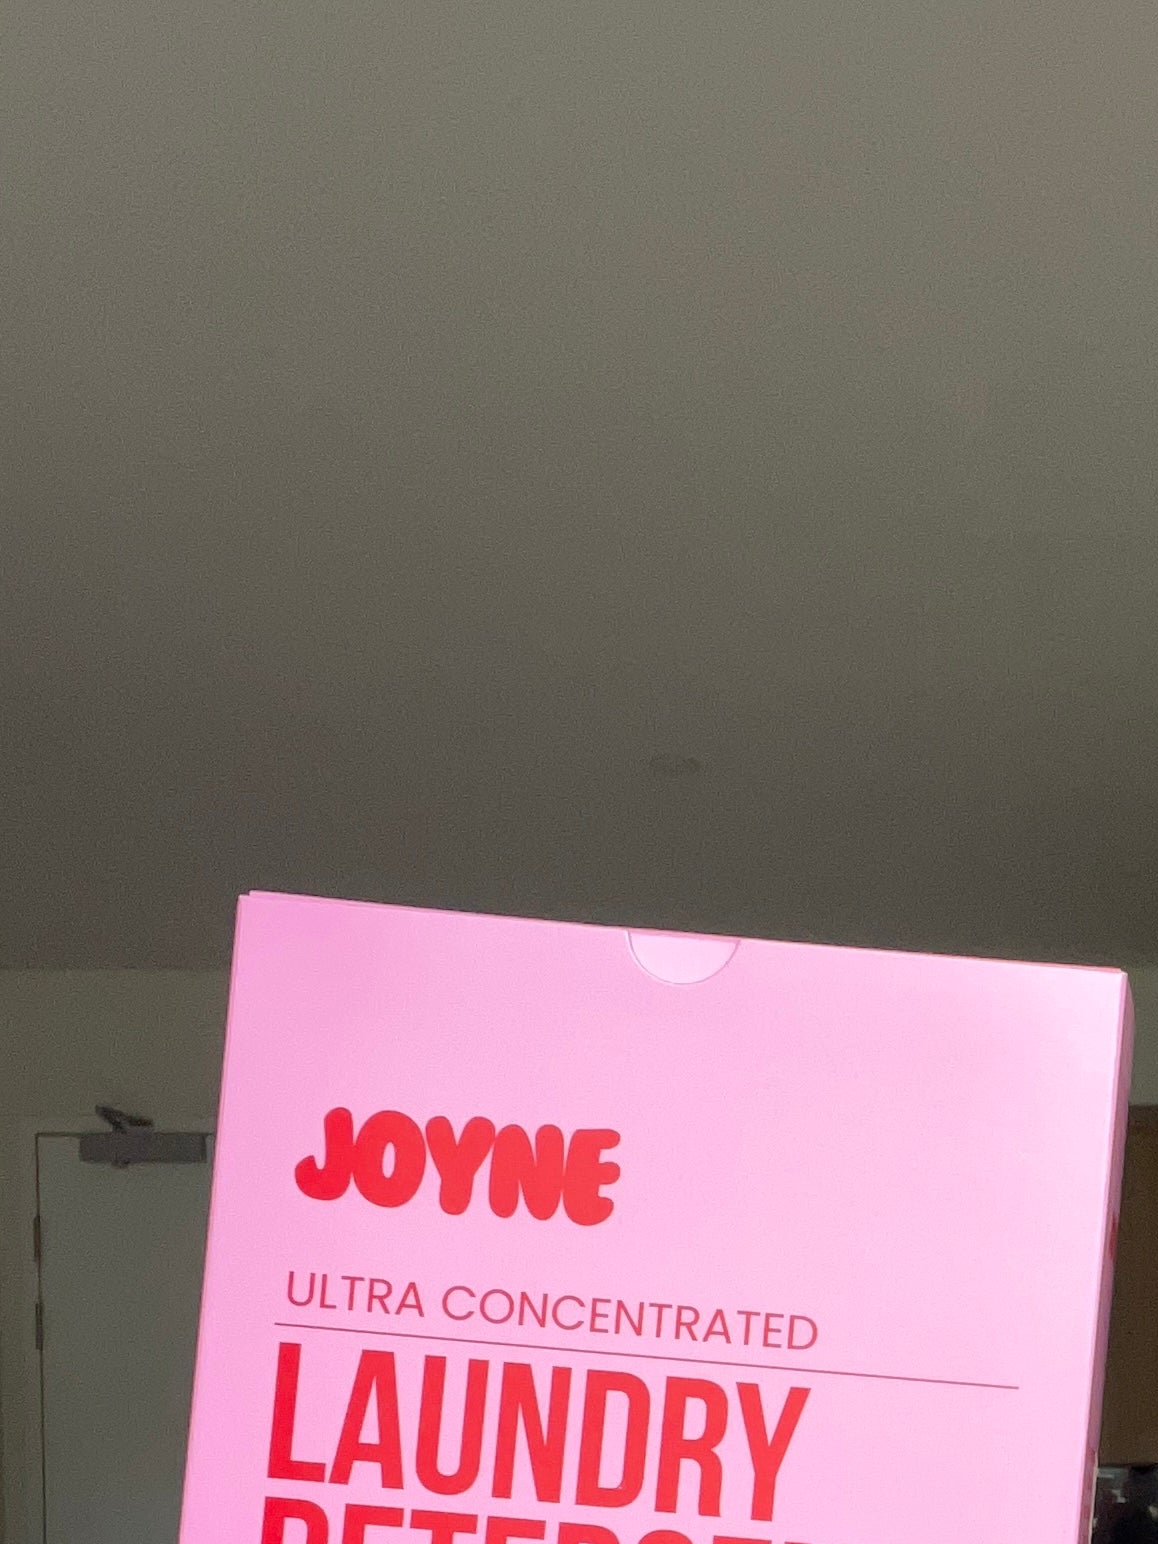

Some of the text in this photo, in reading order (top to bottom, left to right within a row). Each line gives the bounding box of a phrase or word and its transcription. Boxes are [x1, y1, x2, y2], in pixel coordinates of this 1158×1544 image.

[294, 1107, 621, 1227] JOYNE
[287, 1271, 819, 1350] ULTRA CONCENTRATED
[267, 1342, 811, 1523] LAUNDRY
